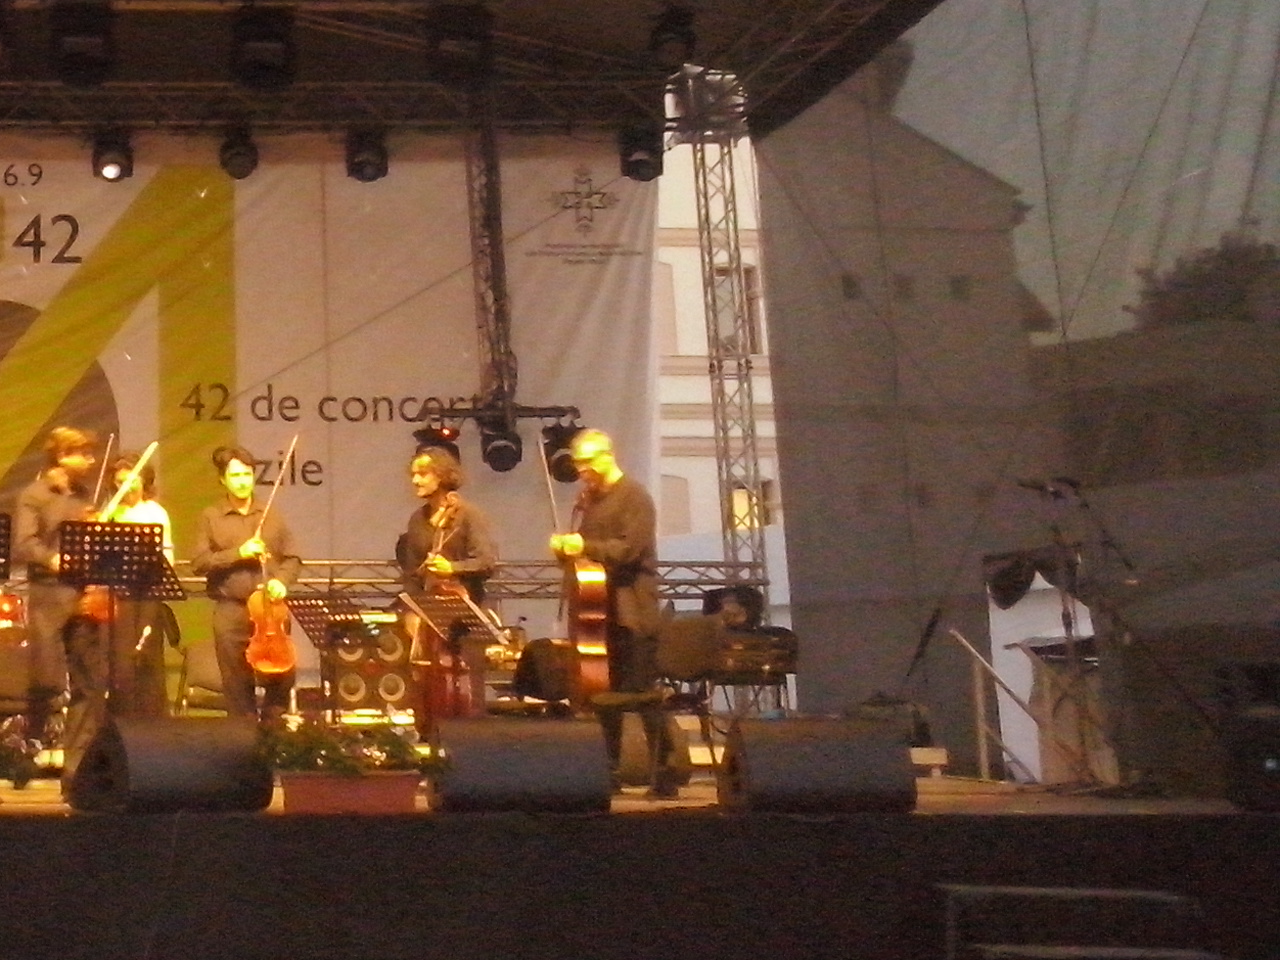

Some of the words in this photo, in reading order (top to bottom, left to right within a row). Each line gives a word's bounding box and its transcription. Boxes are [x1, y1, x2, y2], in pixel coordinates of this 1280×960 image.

[3, 163, 44, 187] 6.9
[179, 382, 233, 422] 42
[250, 383, 301, 422] de
[255, 447, 324, 487] zile
